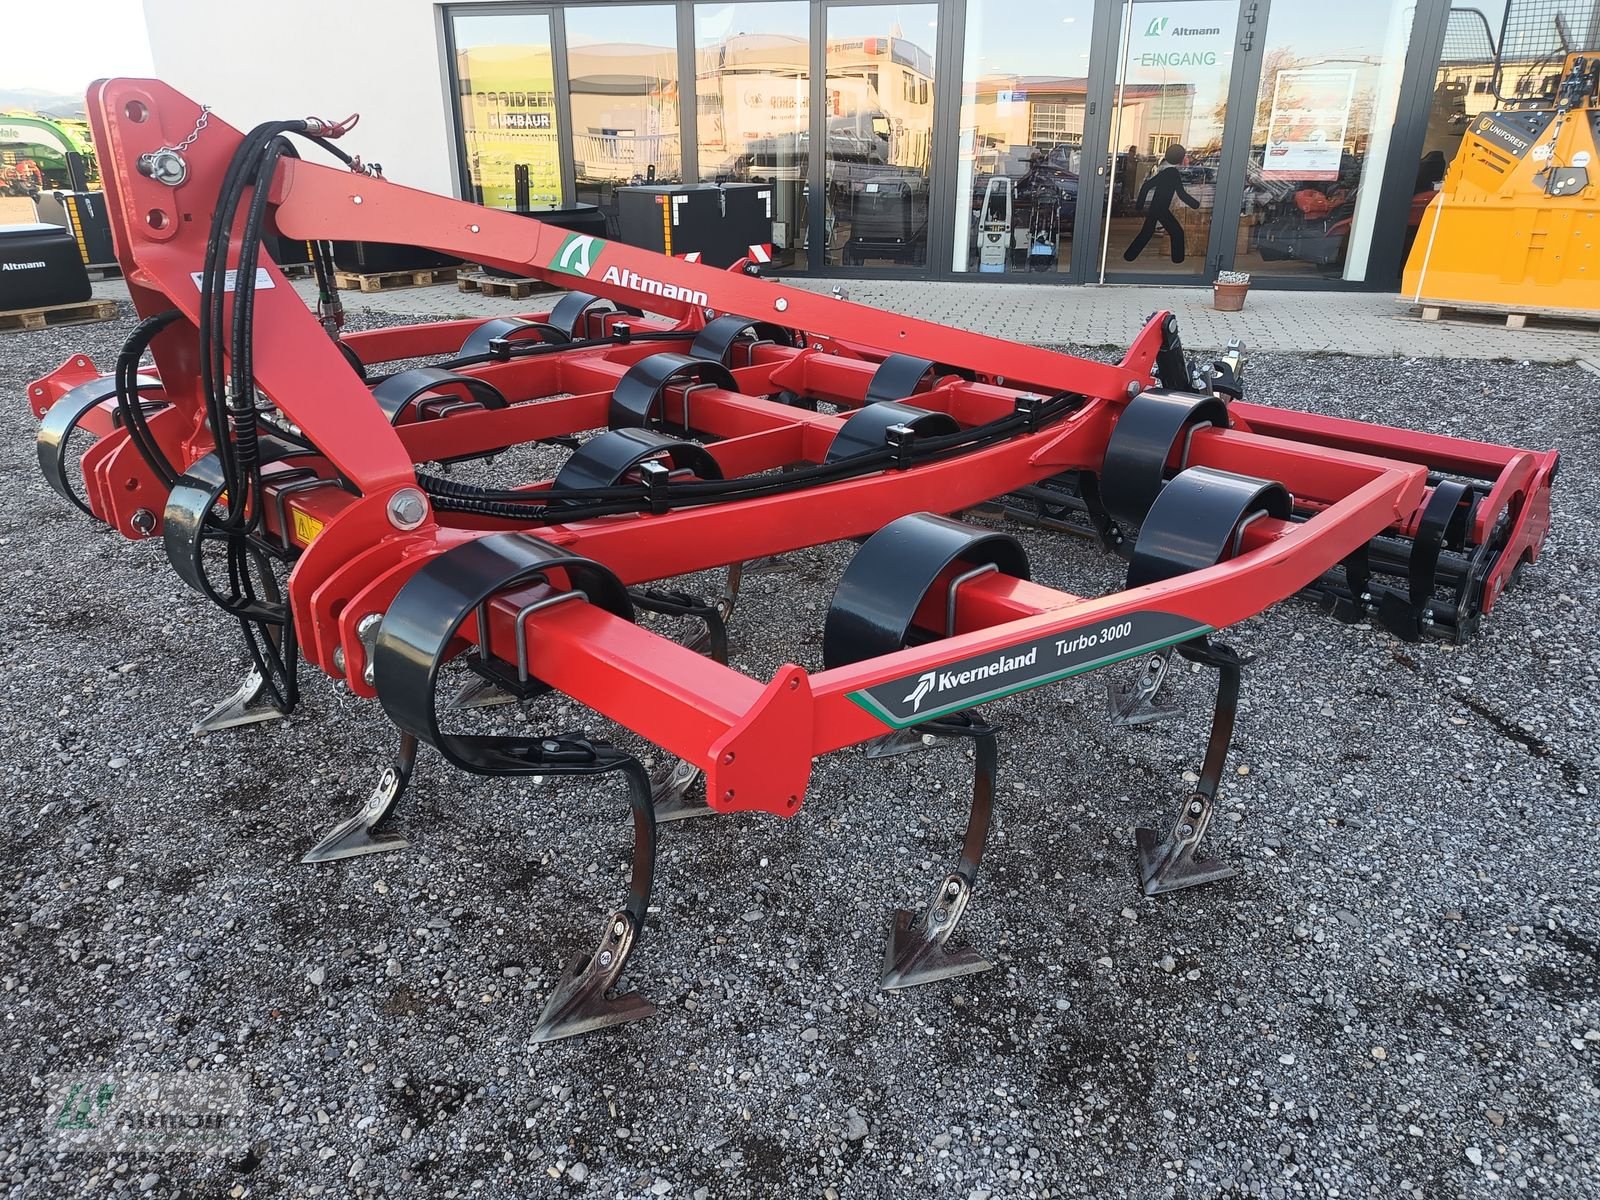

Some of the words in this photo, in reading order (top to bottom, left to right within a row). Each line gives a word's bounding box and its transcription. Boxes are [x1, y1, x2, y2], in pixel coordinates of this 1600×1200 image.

[1171, 26, 1220, 36] Altmann
[1141, 51, 1216, 67] EINGANG
[490, 113, 549, 127] HUMBAUR
[1489, 124, 1529, 150] UNIFOREST
[2, 260, 46, 271] Altmann
[602, 265, 708, 306] Altmann
[938, 647, 1037, 692] Kverneland
[1055, 633, 1097, 657] Turbo
[1099, 621, 1132, 643] 3000
